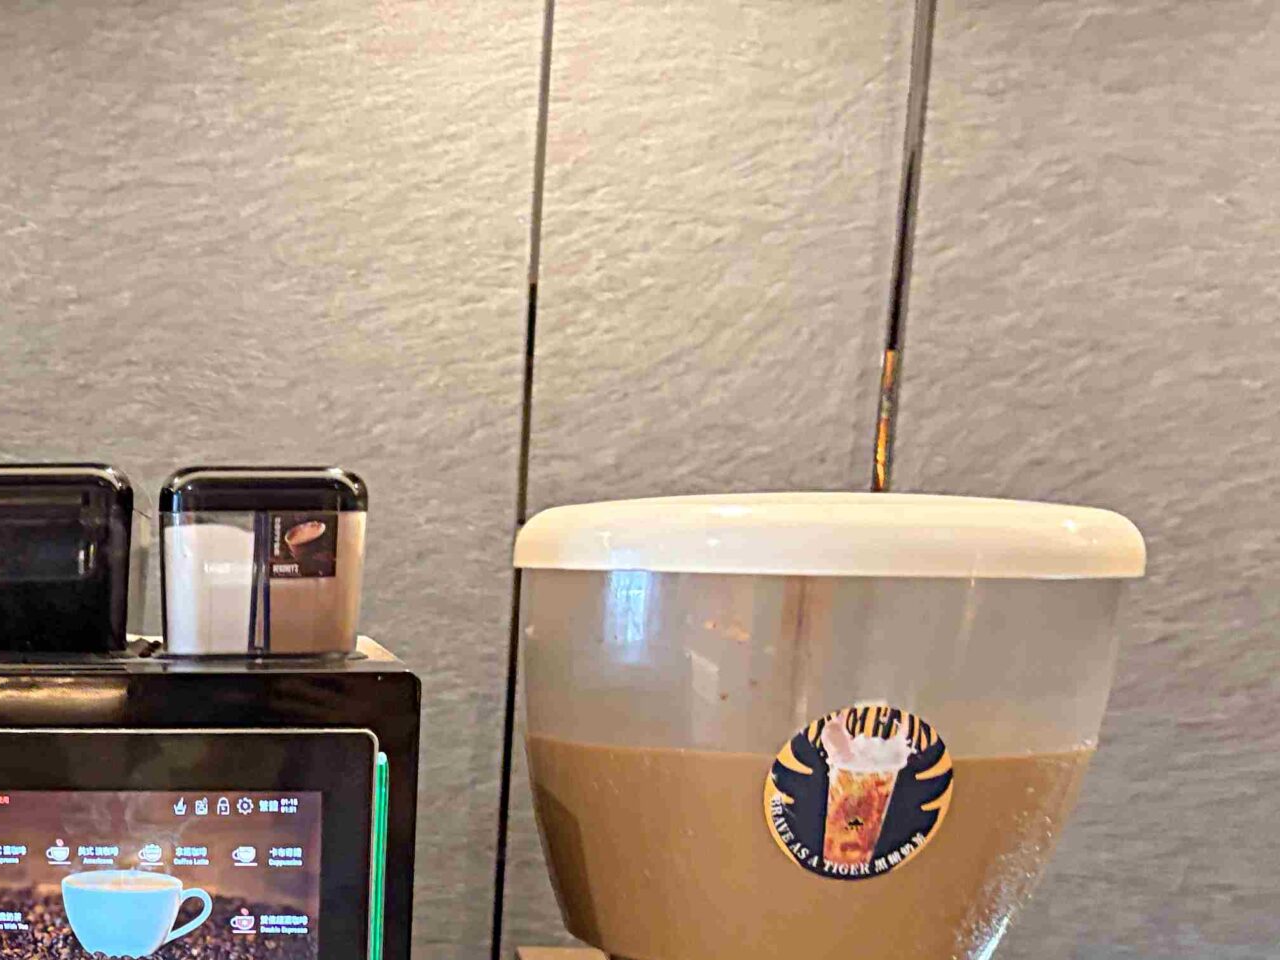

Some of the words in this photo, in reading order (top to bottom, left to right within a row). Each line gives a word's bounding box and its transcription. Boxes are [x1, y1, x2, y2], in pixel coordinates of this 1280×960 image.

[769, 797, 795, 844] BRAVE
[789, 841, 810, 860] AS
[807, 855, 819, 869] A
[823, 859, 870, 876] TIGER
